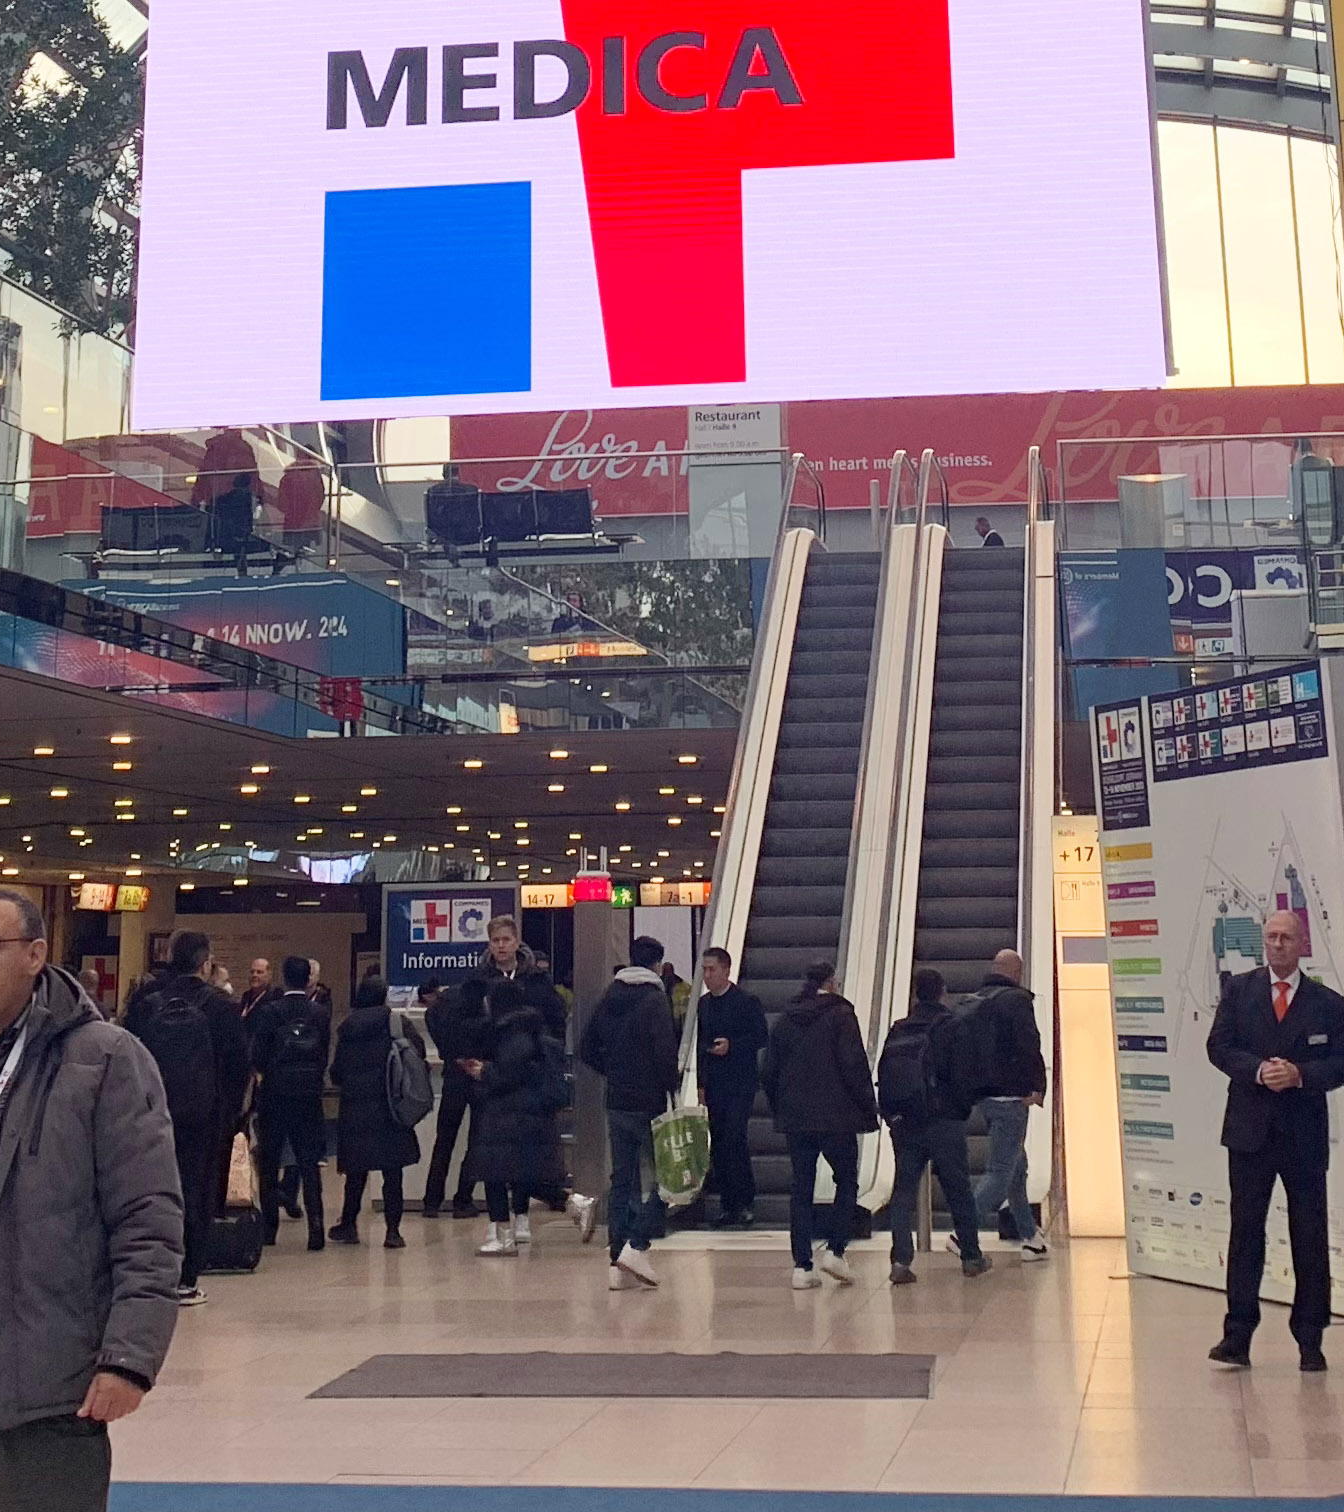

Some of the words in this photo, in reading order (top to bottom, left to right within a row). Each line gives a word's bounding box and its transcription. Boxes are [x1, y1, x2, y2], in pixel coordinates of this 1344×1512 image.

[325, 25, 804, 131] MEDICA
[695, 410, 761, 422] Restaurant
[829, 456, 868, 472] heart
[873, 456, 919, 470] mes
[921, 453, 993, 469] siness.
[403, 951, 482, 969] Informati
